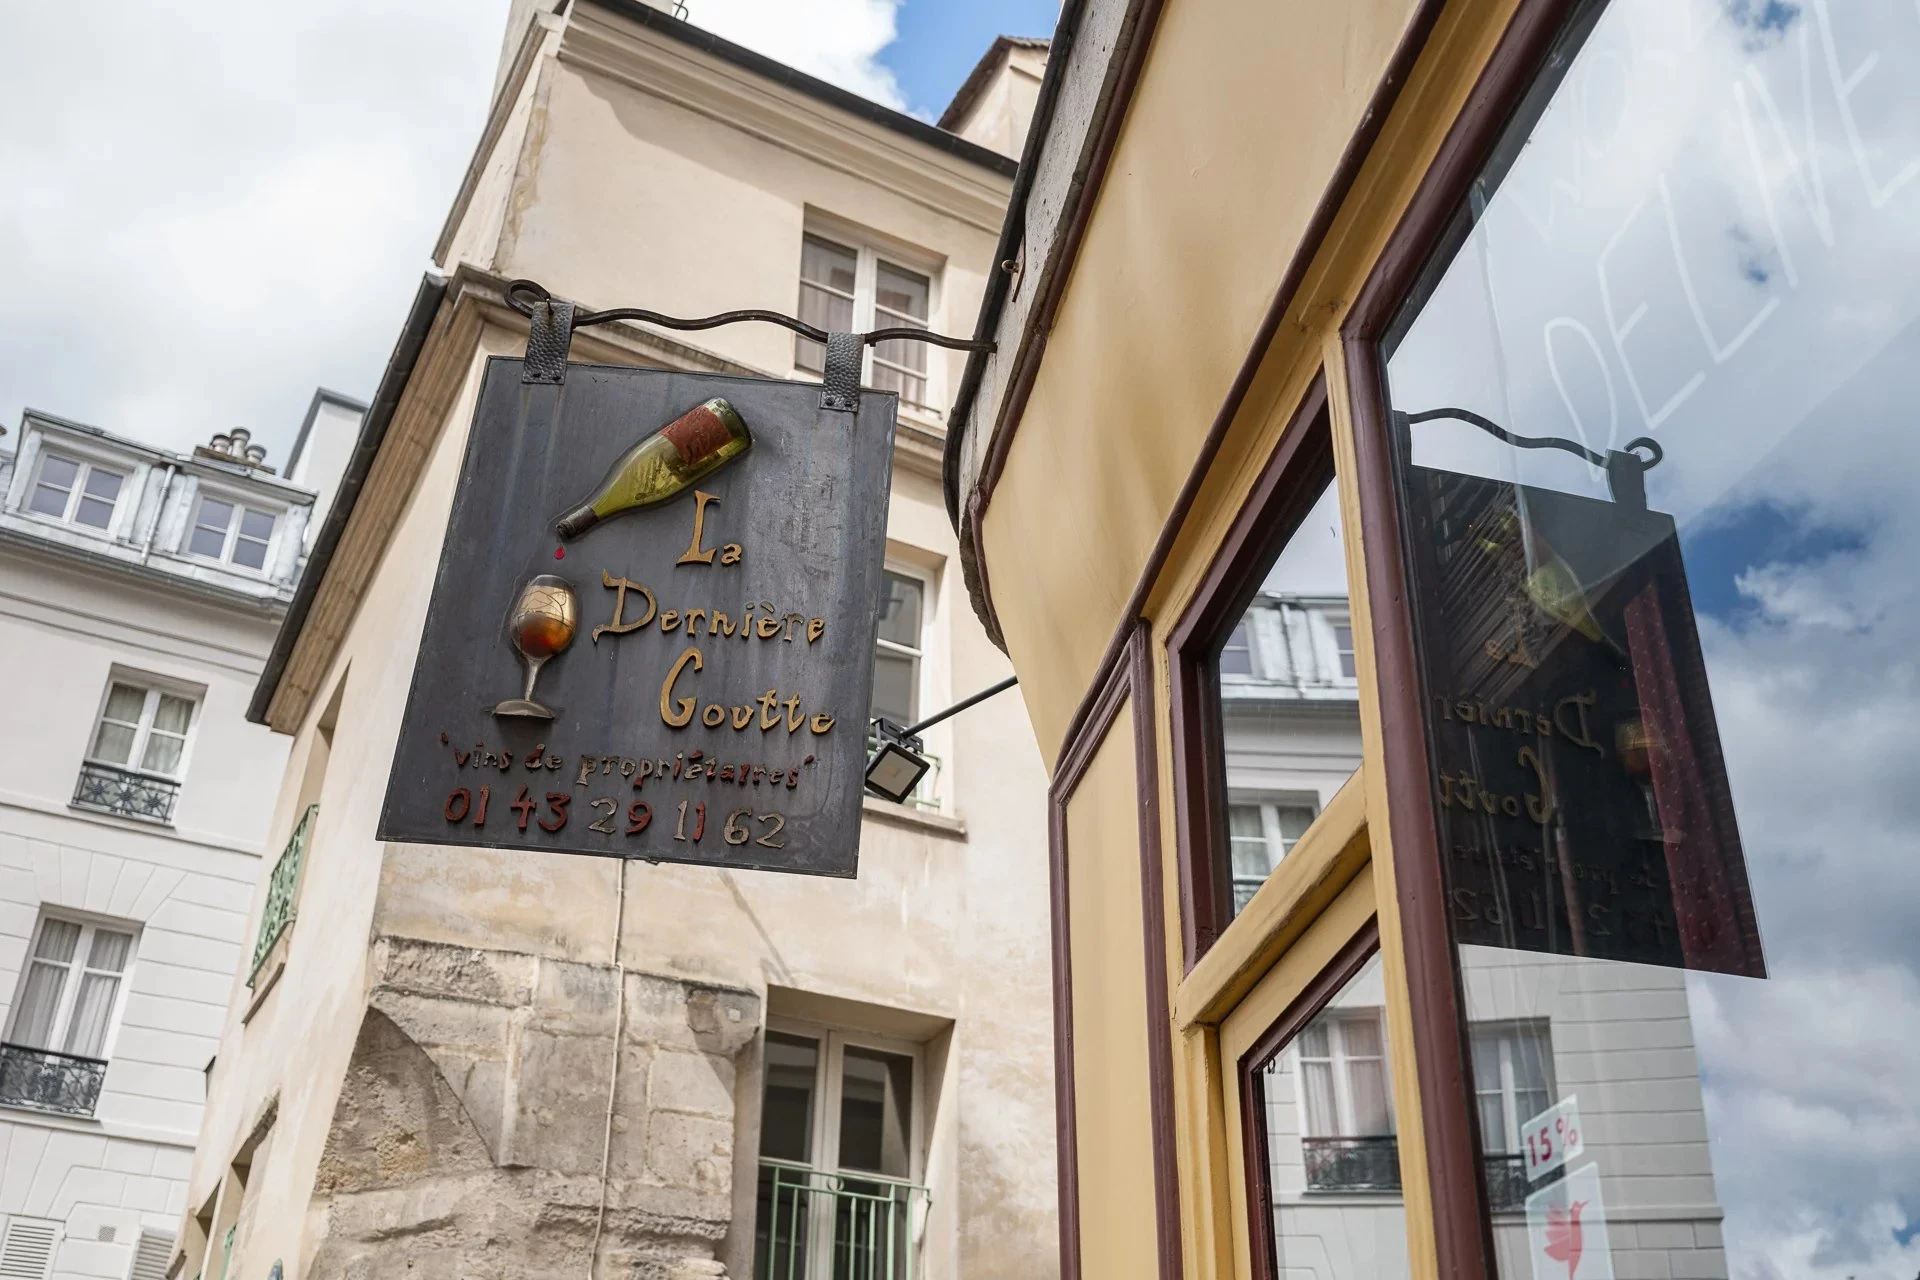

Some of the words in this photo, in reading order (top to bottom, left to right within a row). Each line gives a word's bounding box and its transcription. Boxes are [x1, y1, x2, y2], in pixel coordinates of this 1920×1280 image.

[676, 490, 743, 567] La
[592, 568, 825, 643] Dernière
[660, 647, 836, 735] Goutte
[524, 743, 563, 770] de
[444, 785, 490, 826] 01
[510, 784, 572, 833] 43
[588, 796, 653, 836] 29
[673, 799, 706, 842] 11
[723, 808, 786, 849] 62
